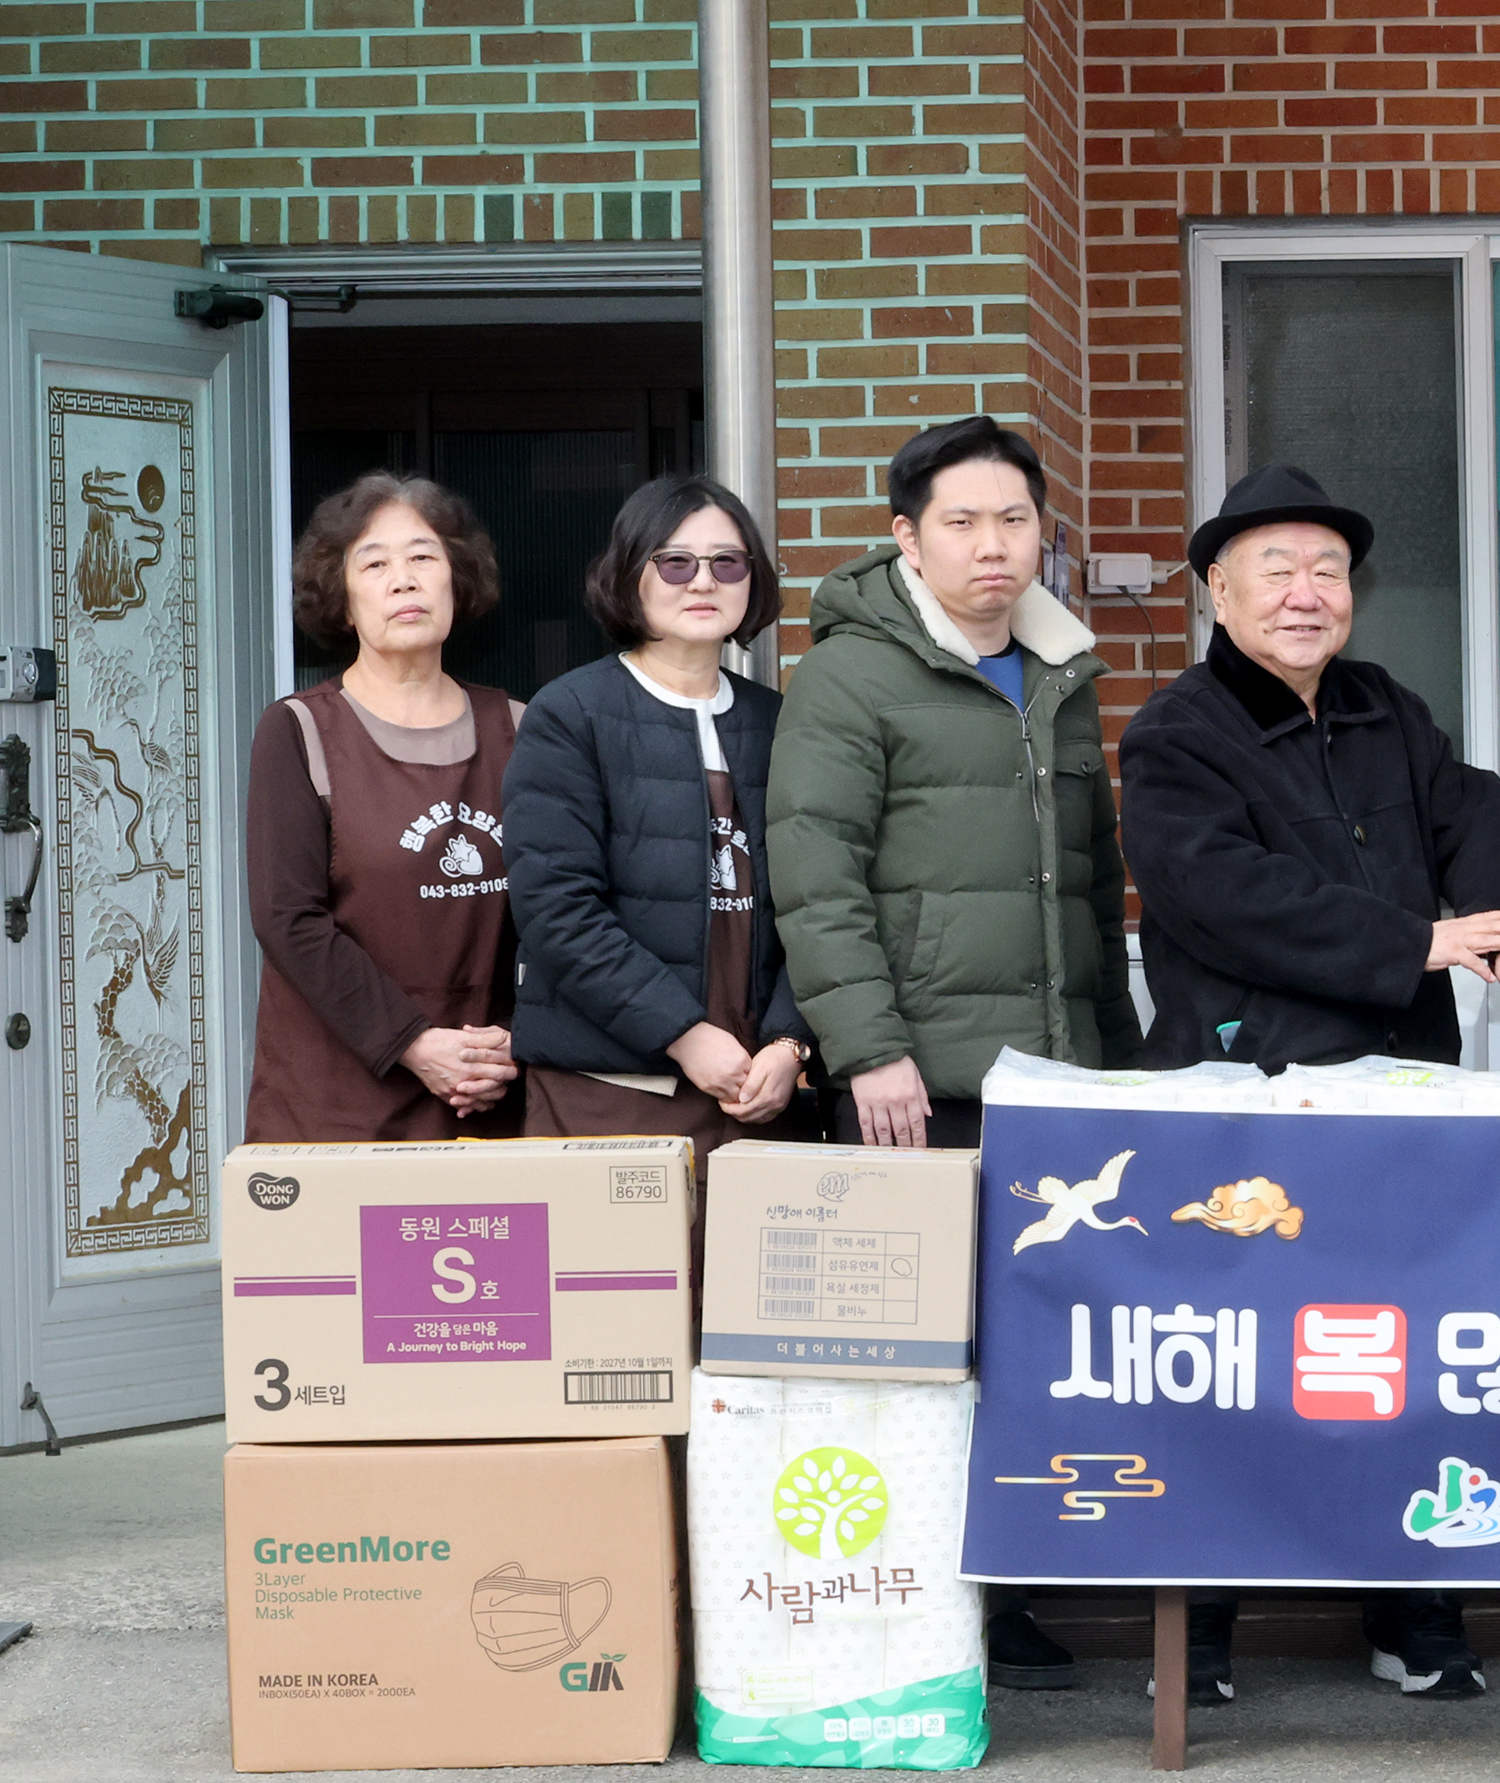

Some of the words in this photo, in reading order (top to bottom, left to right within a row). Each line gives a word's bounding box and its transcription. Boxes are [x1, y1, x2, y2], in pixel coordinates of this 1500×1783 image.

[399, 800, 454, 853] 행복한
[616, 1171, 661, 1185] 발주코드
[254, 1183, 294, 1195] DONG
[616, 1185, 662, 1199] 86790
[259, 1195, 290, 1205] WON
[766, 1205, 802, 1220] 신망애
[399, 1217, 440, 1241] 동원
[447, 1216, 510, 1240] 스페셜
[829, 1259, 879, 1272] 섬유유연제
[826, 1282, 846, 1294] 욕실
[849, 1283, 879, 1295] 세정제
[837, 1305, 867, 1317] 물비누
[414, 1322, 451, 1338] 건강을
[453, 1324, 471, 1336] 담은
[473, 1321, 498, 1336] 마음
[386, 1342, 396, 1352] A
[398, 1342, 443, 1354] Journey
[446, 1342, 458, 1351] to
[460, 1341, 494, 1353] Bright
[497, 1341, 527, 1352] Hope
[600, 1358, 626, 1368] 2027년
[628, 1358, 644, 1368] 10월
[646, 1357, 673, 1368] 1일까지
[1049, 1303, 1258, 1411] 새해
[1296, 1309, 1402, 1415] 복
[727, 1405, 765, 1415] Caritas
[254, 1536, 451, 1564] GreenMore
[254, 1572, 306, 1588] 3Layer
[255, 1588, 338, 1605] Disposable
[343, 1587, 422, 1601] Protective
[740, 1566, 923, 1625] 사람과나무
[255, 1606, 295, 1620] Mask
[258, 1674, 302, 1688] MADE
[308, 1674, 323, 1687] IN
[327, 1673, 379, 1687] KOREA
[259, 1690, 321, 1699] INBOX(50EA)
[332, 1688, 366, 1698] 40BOX
[377, 1687, 416, 1697] 2000EA
[903, 1719, 914, 1728] 30
[928, 1717, 939, 1727] 30
